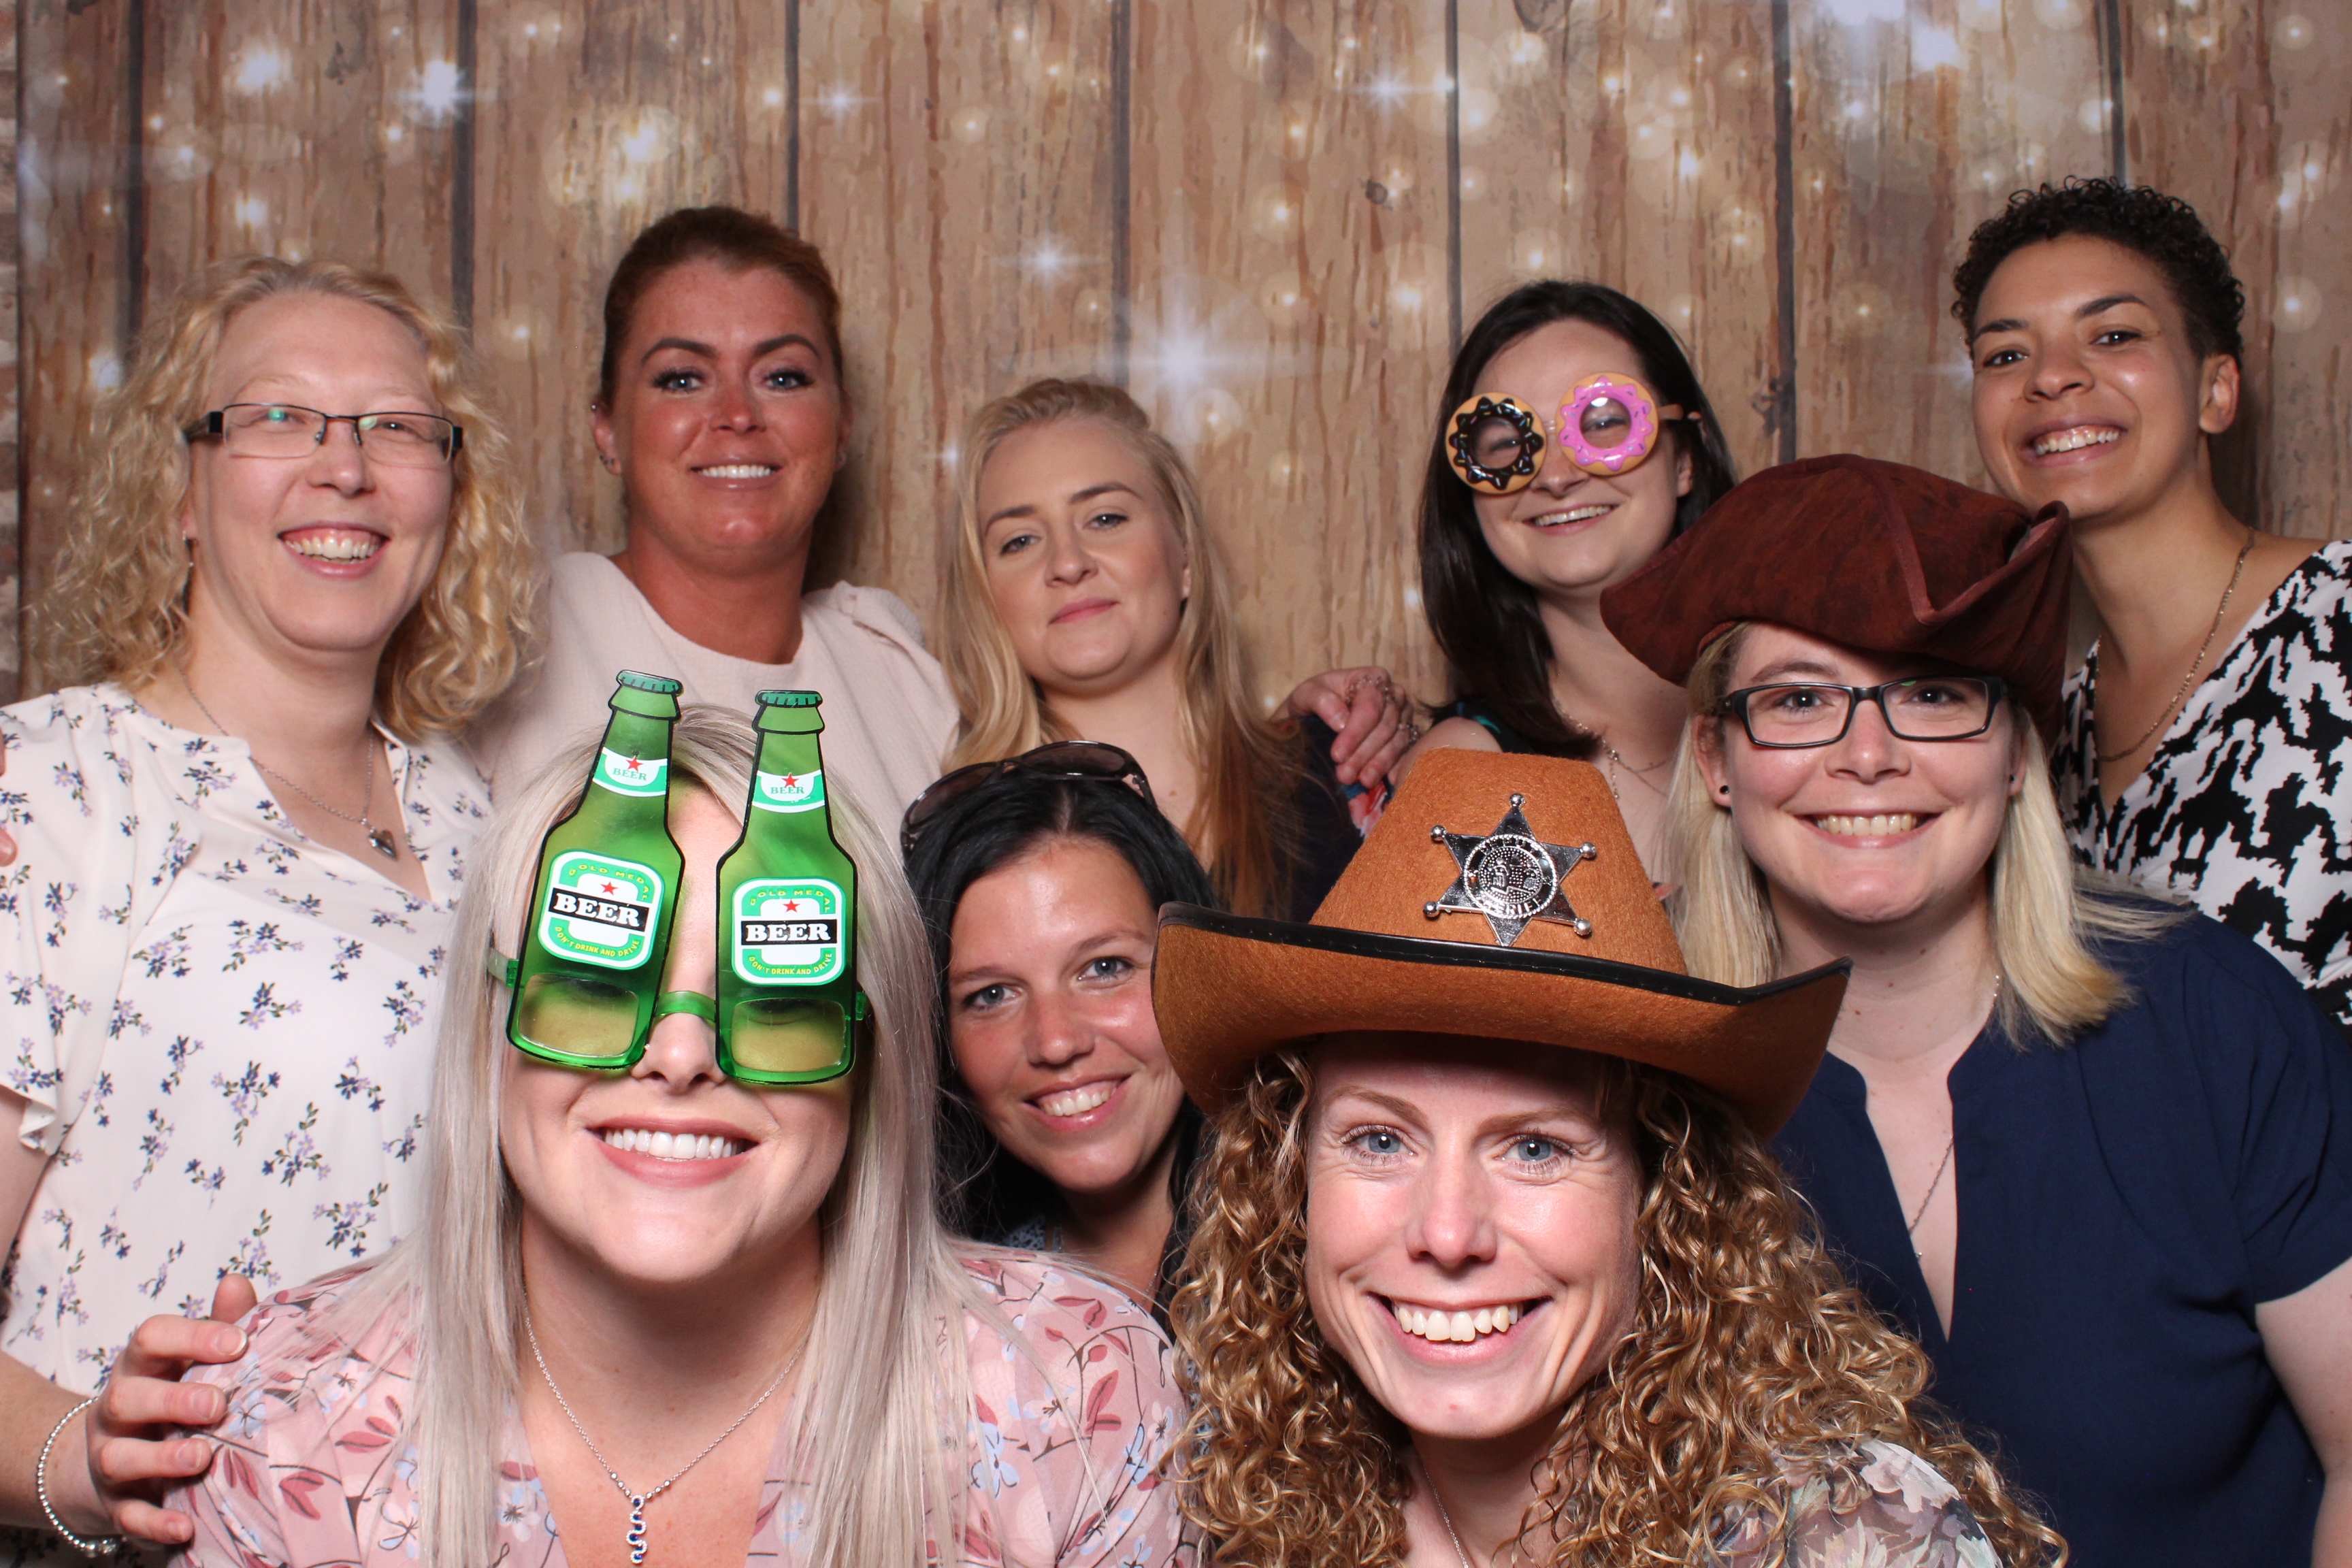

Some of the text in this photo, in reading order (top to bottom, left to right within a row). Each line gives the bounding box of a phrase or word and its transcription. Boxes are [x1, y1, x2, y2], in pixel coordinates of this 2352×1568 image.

[612, 768, 647, 781] BEER
[770, 786, 805, 795] BEER
[568, 864, 650, 900] GOLD MEDAL
[553, 892, 640, 927] BEER
[750, 889, 831, 913] GOLD MEDAL
[555, 926, 640, 957] DON'T DRINK AND DRIVE
[745, 923, 831, 942] BEER
[749, 956, 770, 973] DON'T
[814, 953, 832, 973] DRIVE
